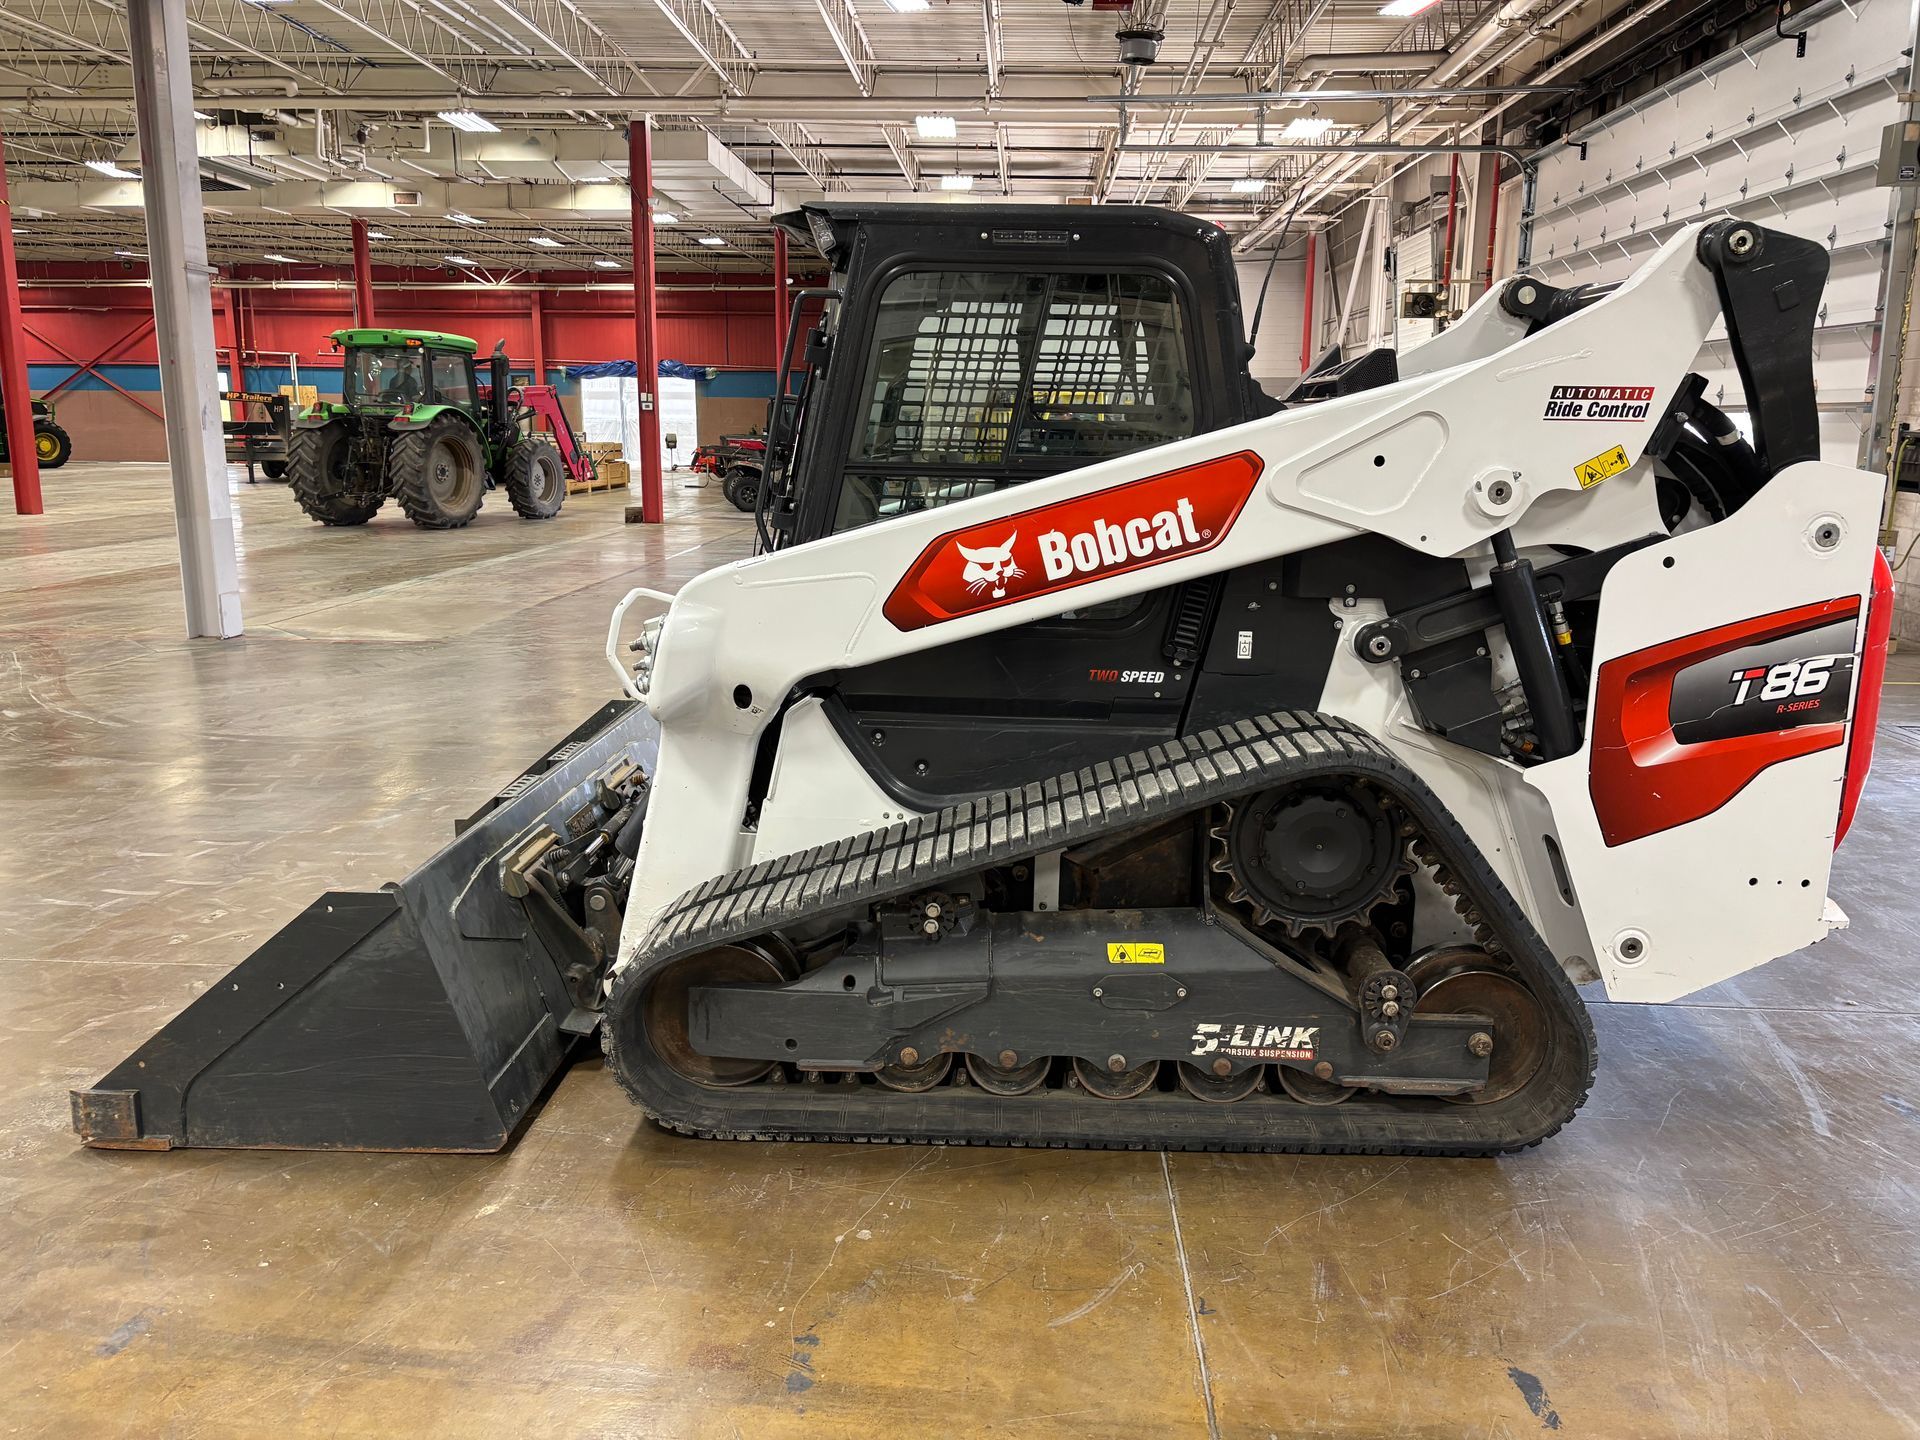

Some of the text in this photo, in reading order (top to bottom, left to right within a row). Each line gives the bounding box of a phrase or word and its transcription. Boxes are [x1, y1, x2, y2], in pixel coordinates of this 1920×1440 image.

[226, 392, 273, 403] HP Trailers
[1554, 388, 1651, 400] AUTOMATIC
[273, 405, 284, 413] HP
[1544, 401, 1650, 418] Ride Control
[1037, 497, 1201, 581] Bobcat
[1089, 669, 1165, 684] TWO SPEED
[1731, 658, 1836, 705] T86
[1776, 699, 1820, 714] R-SERIES
[1191, 1023, 1320, 1056] 5-LINK
[1259, 1049, 1312, 1059] SUSPENSION
